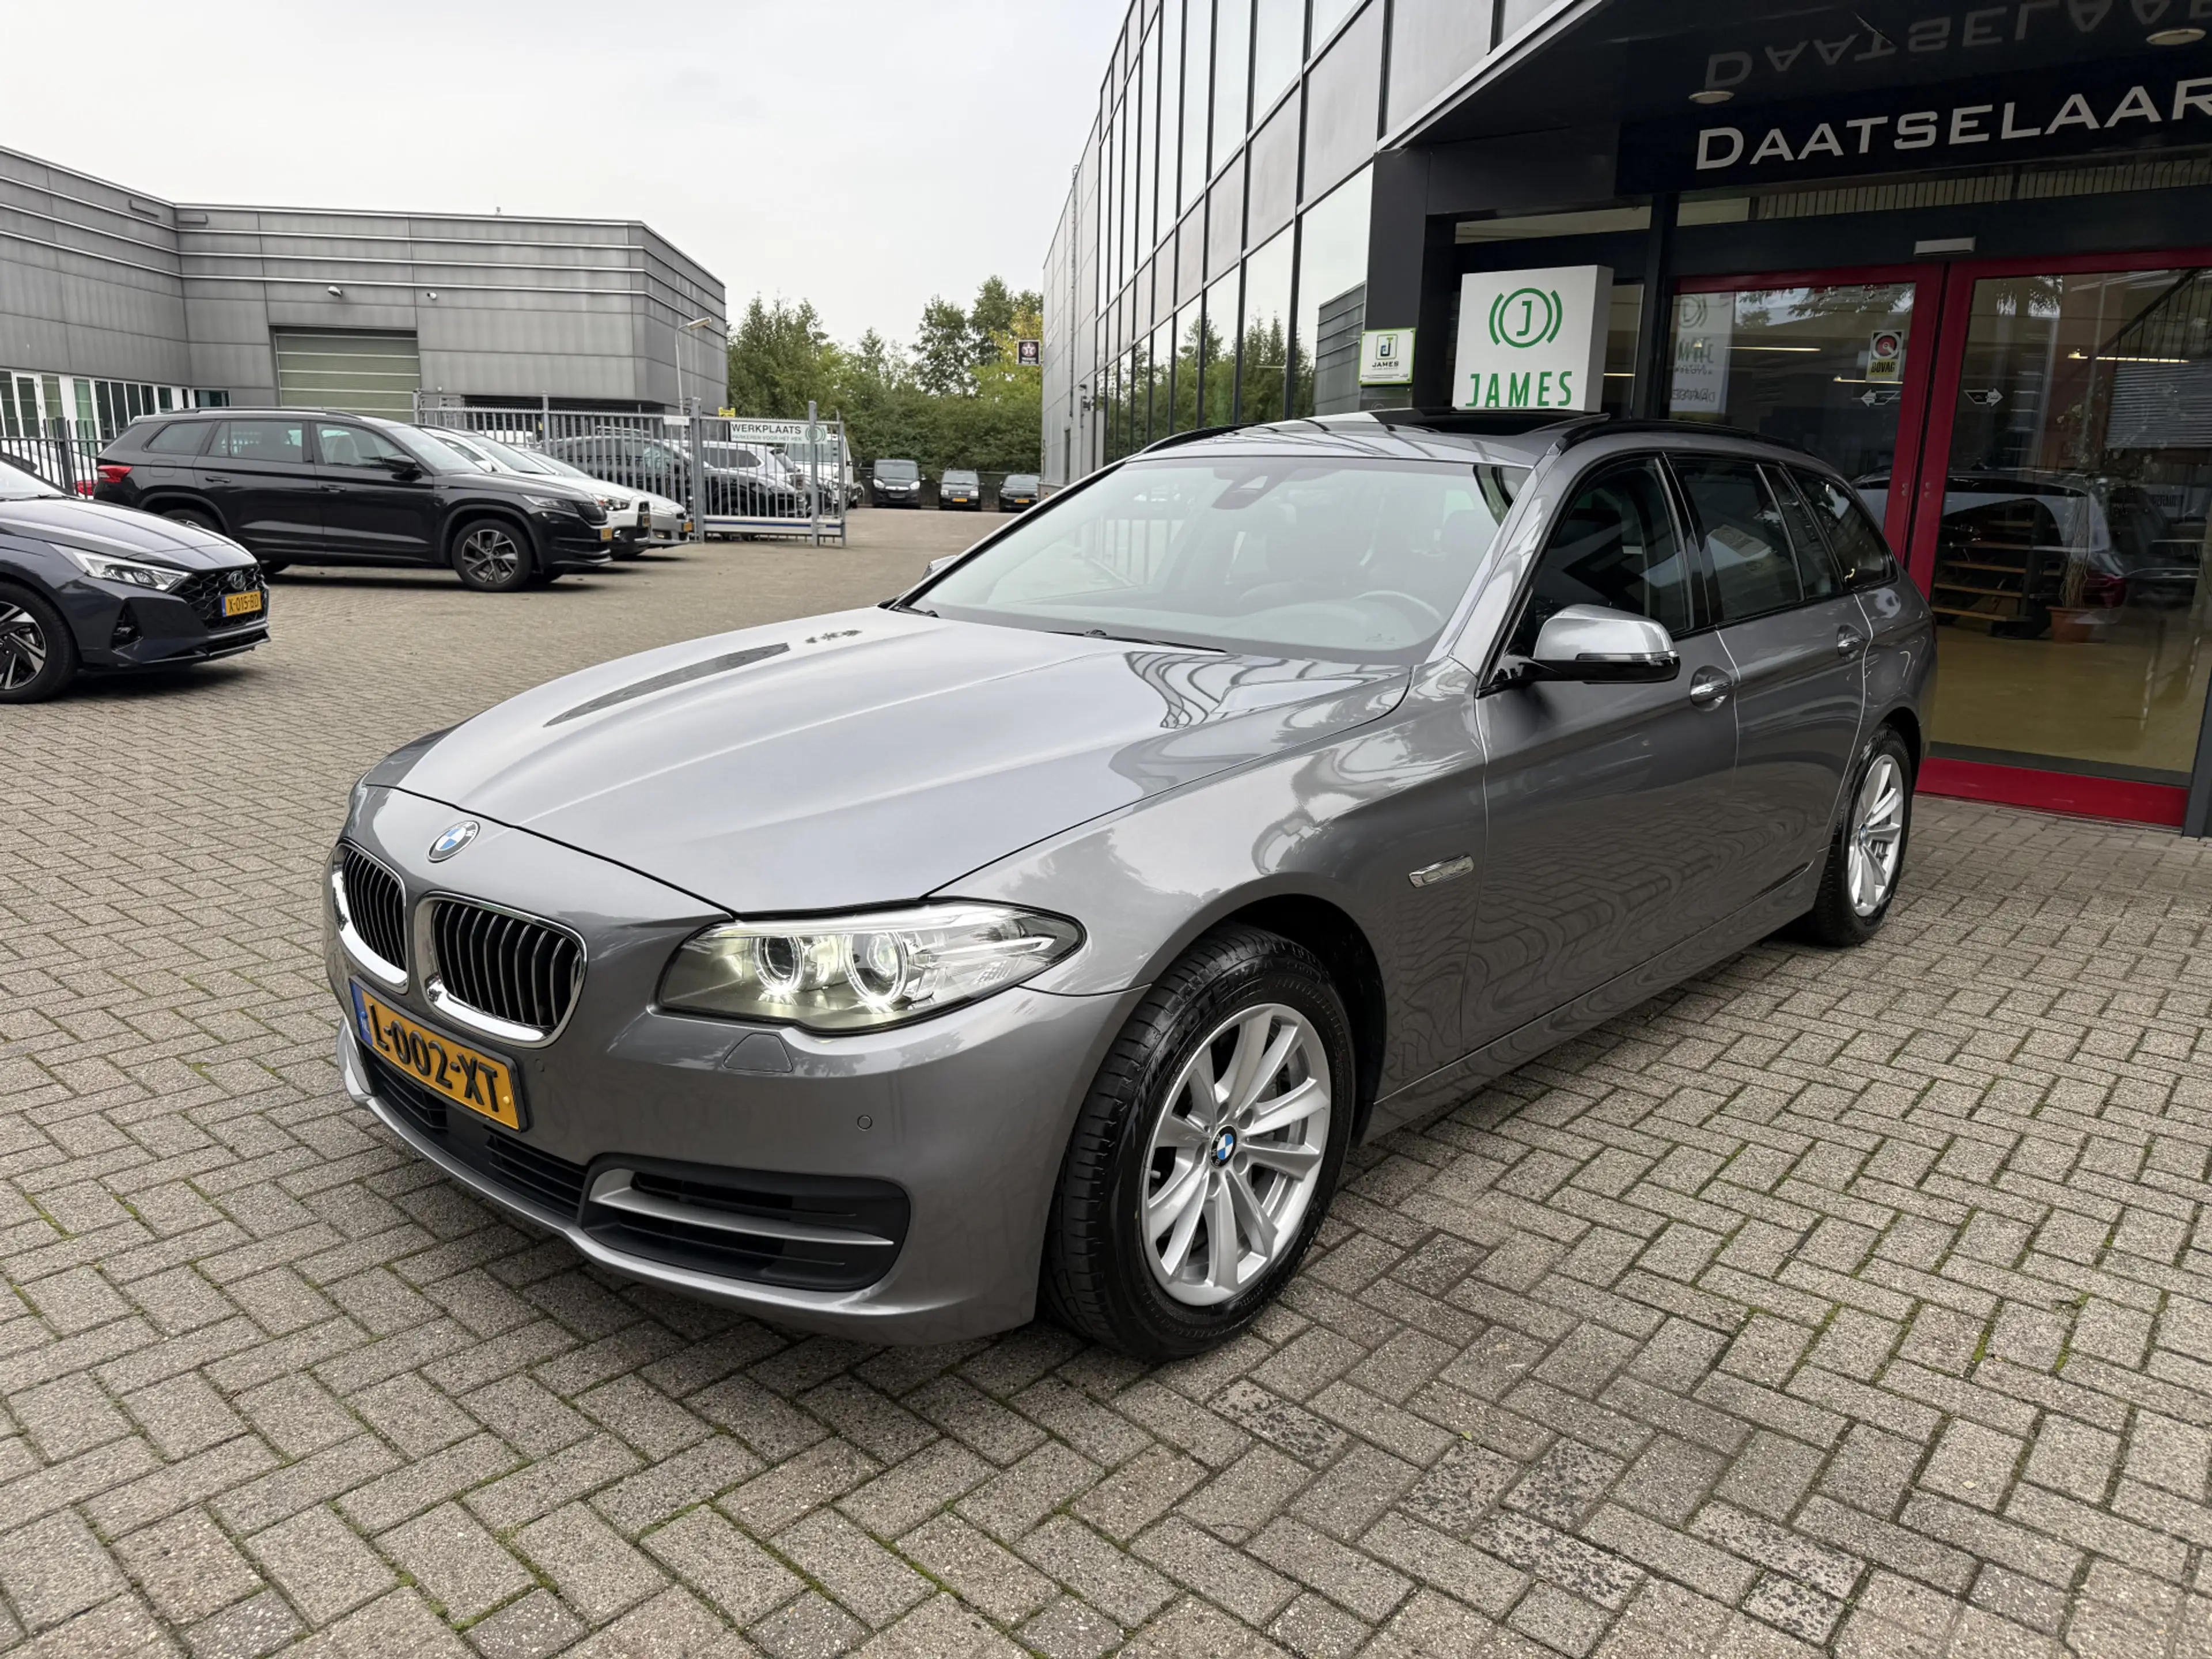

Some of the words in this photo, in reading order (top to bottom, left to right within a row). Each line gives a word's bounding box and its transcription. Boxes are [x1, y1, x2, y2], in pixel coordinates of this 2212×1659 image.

[1696, 77, 2212, 171] DAATSELAAR
[1871, 361, 1896, 373] BOVAG
[1465, 371, 1573, 408] JAMES
[732, 424, 802, 434] WERKPLAATS
[369, 1003, 499, 1113] L-002-XT
